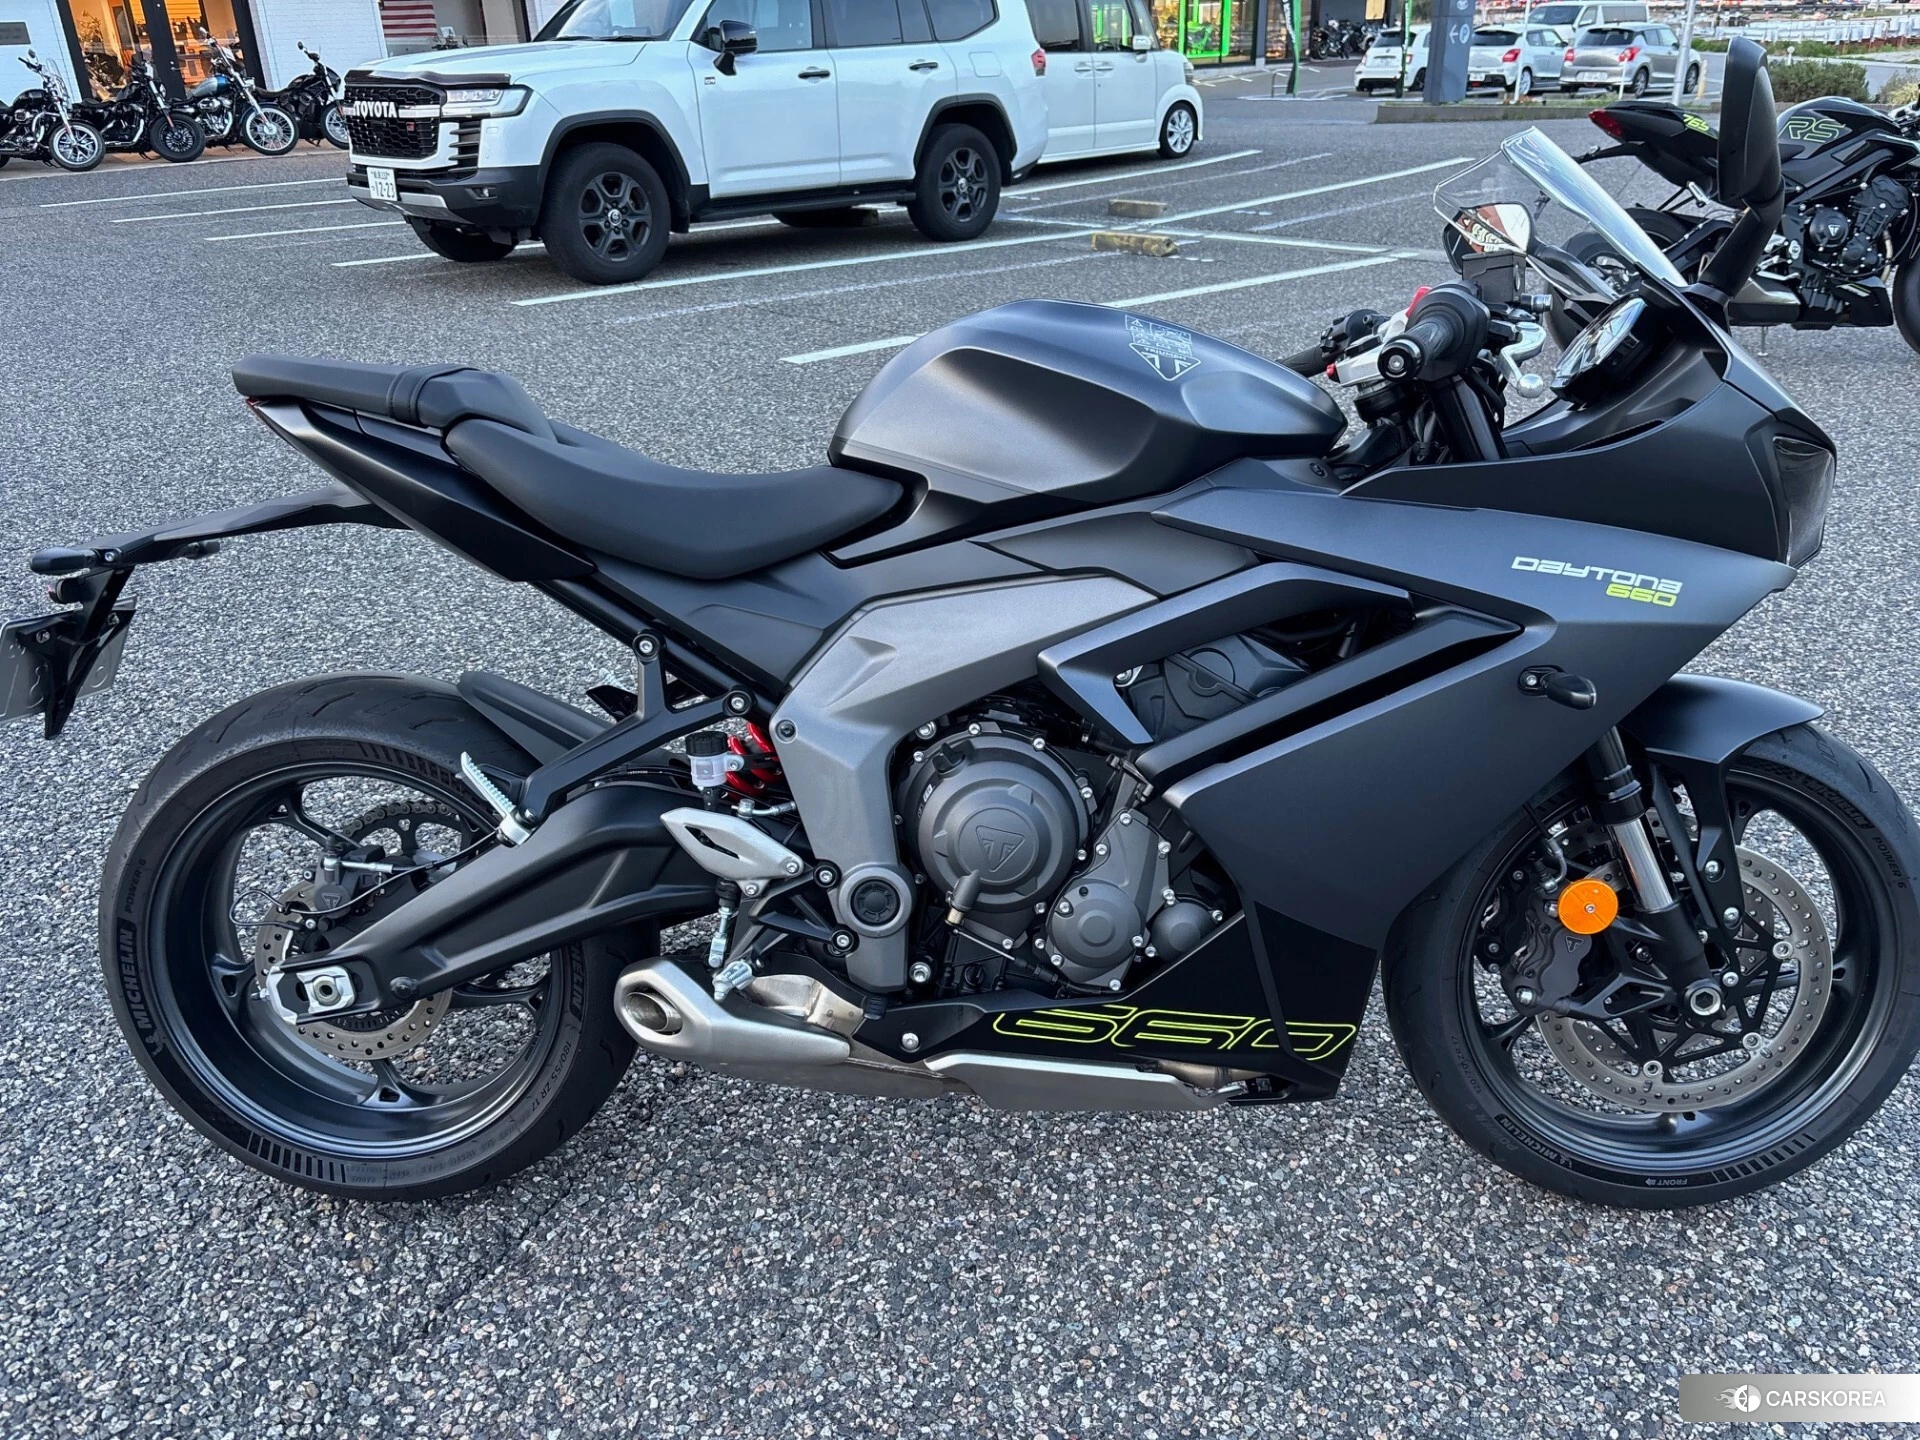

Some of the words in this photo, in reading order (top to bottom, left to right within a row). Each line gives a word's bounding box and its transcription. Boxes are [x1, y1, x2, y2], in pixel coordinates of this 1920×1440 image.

[354, 101, 397, 118] TOYOTA
[1682, 113, 1710, 131] 765
[1778, 116, 1846, 143] RS
[1605, 583, 1678, 607] 660
[1872, 836, 1902, 877] POWER
[125, 870, 143, 913] POWER
[119, 928, 153, 1029] MICHELIN
[992, 1004, 1356, 1060] 660
[551, 1041, 571, 1081] 180/55
[532, 1099, 540, 1112] 17
[540, 1082, 552, 1099] ZR
[1500, 1117, 1559, 1160] MICHELIN
